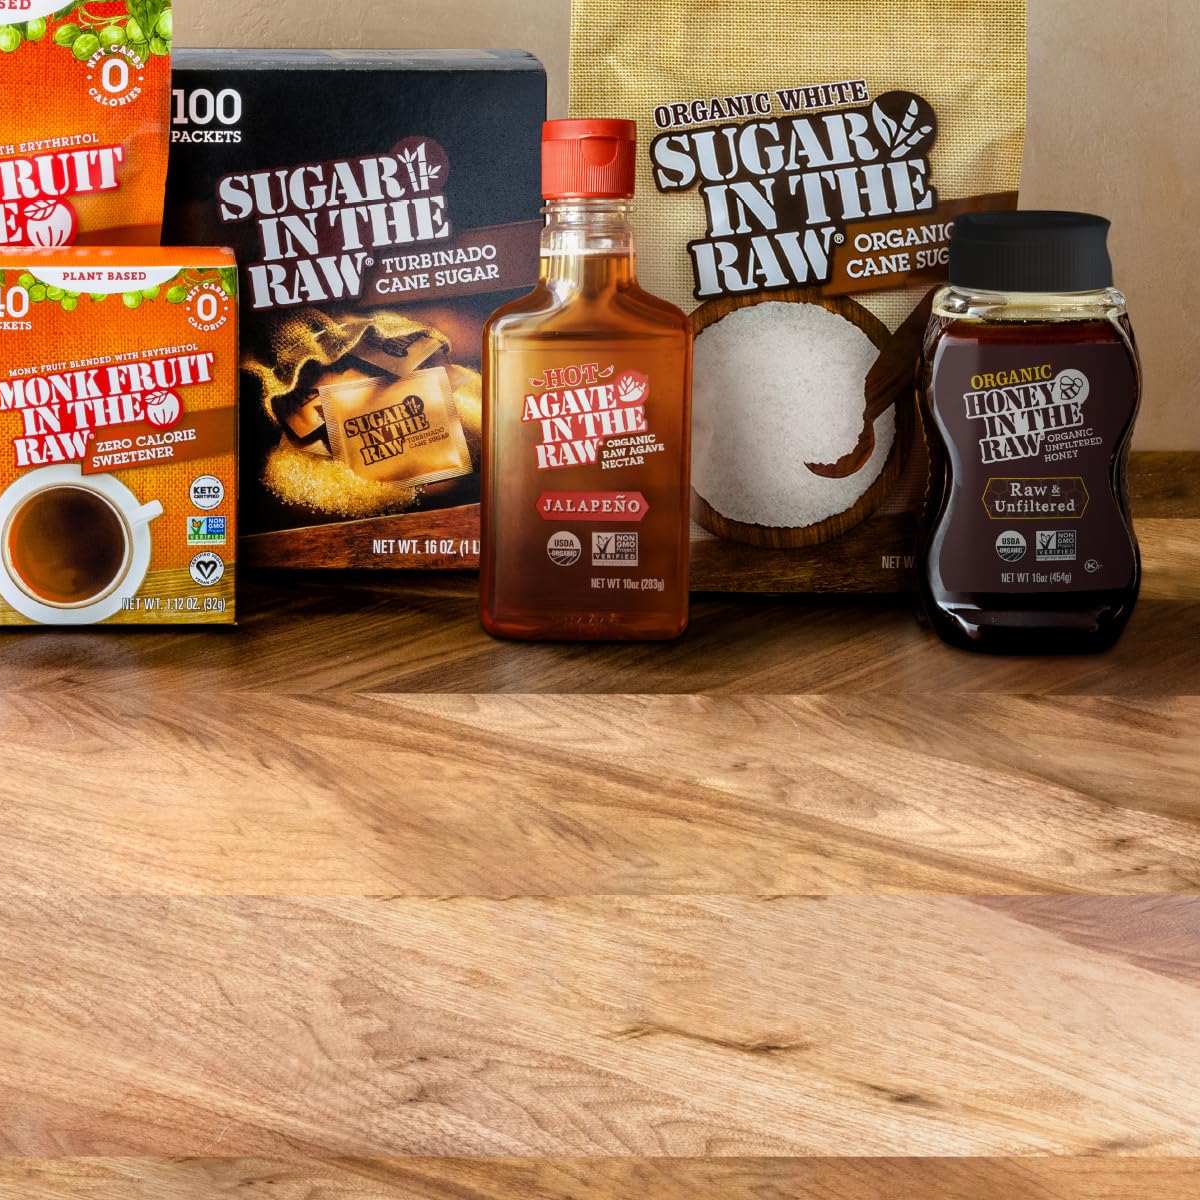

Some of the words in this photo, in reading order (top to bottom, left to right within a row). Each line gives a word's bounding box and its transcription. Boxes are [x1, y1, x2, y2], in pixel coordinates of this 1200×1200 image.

[172, 88, 242, 125] 100
[654, 91, 771, 129] ORGANIC
[775, 79, 869, 112] WHITE
[19, 133, 99, 152] ERYTHRITOL
[171, 130, 242, 143] PACKETS
[654, 112, 879, 188] SUGAR
[219, 156, 405, 221] SUGAR
[704, 178, 778, 238] IN
[788, 159, 932, 224] THE
[258, 213, 319, 261] IN
[329, 195, 449, 250] THE
[854, 222, 954, 253] ORGANIC
[382, 244, 497, 274] TURBINADO
[846, 253, 911, 278] CANE
[62, 271, 104, 281] PLANT
[108, 271, 147, 281] BASED
[376, 273, 430, 294] CANE
[436, 264, 500, 287] SUGAR
[9, 367, 38, 377] MONK
[41, 363, 67, 373] FRUIT
[70, 356, 111, 369] BLENDED
[114, 352, 138, 362] WITH
[142, 344, 199, 358] ERYTHRITOL
[106, 353, 214, 395] FRUIT
[543, 363, 599, 389] HOT
[970, 364, 1052, 390] ORGANIC
[522, 384, 617, 420] AGAVE
[964, 382, 1056, 418] HONEY
[22, 404, 62, 436] IN
[67, 393, 145, 430] THE
[540, 416, 573, 444] IN
[578, 406, 646, 438] THE
[985, 413, 1017, 438] IN
[1021, 402, 1082, 432] THE
[96, 438, 132, 452] ZERO
[136, 429, 197, 447] CALORIE
[607, 434, 656, 448] ORGANIC
[1045, 436, 1102, 452] UNFILTERED
[1047, 428, 1094, 443] ORGANIC
[93, 446, 174, 468] SWEETENER
[602, 456, 644, 469] NECTAR
[603, 447, 626, 459] RAW
[629, 443, 665, 456] AGAVE
[1044, 450, 1079, 462] HONEY
[193, 486, 220, 494] KETO
[1010, 482, 1047, 497] Raw
[543, 495, 641, 513] JALAPEÑO
[994, 499, 1076, 512] Unfiltered
[373, 540, 395, 554] NET
[398, 540, 420, 554] WT.
[424, 540, 437, 554] 16
[554, 539, 574, 547] USDA
[591, 578, 605, 588] NET
[607, 578, 621, 589] WT
[623, 578, 639, 589] 10oz
[641, 578, 665, 591] (283g)
[1001, 573, 1015, 583] NET
[1017, 573, 1030, 583] WT
[1049, 572, 1072, 584] (454g)
[122, 597, 141, 610] NET
[144, 598, 164, 610] WT.
[166, 598, 183, 610] 1.12
[186, 598, 200, 610] OZ.
